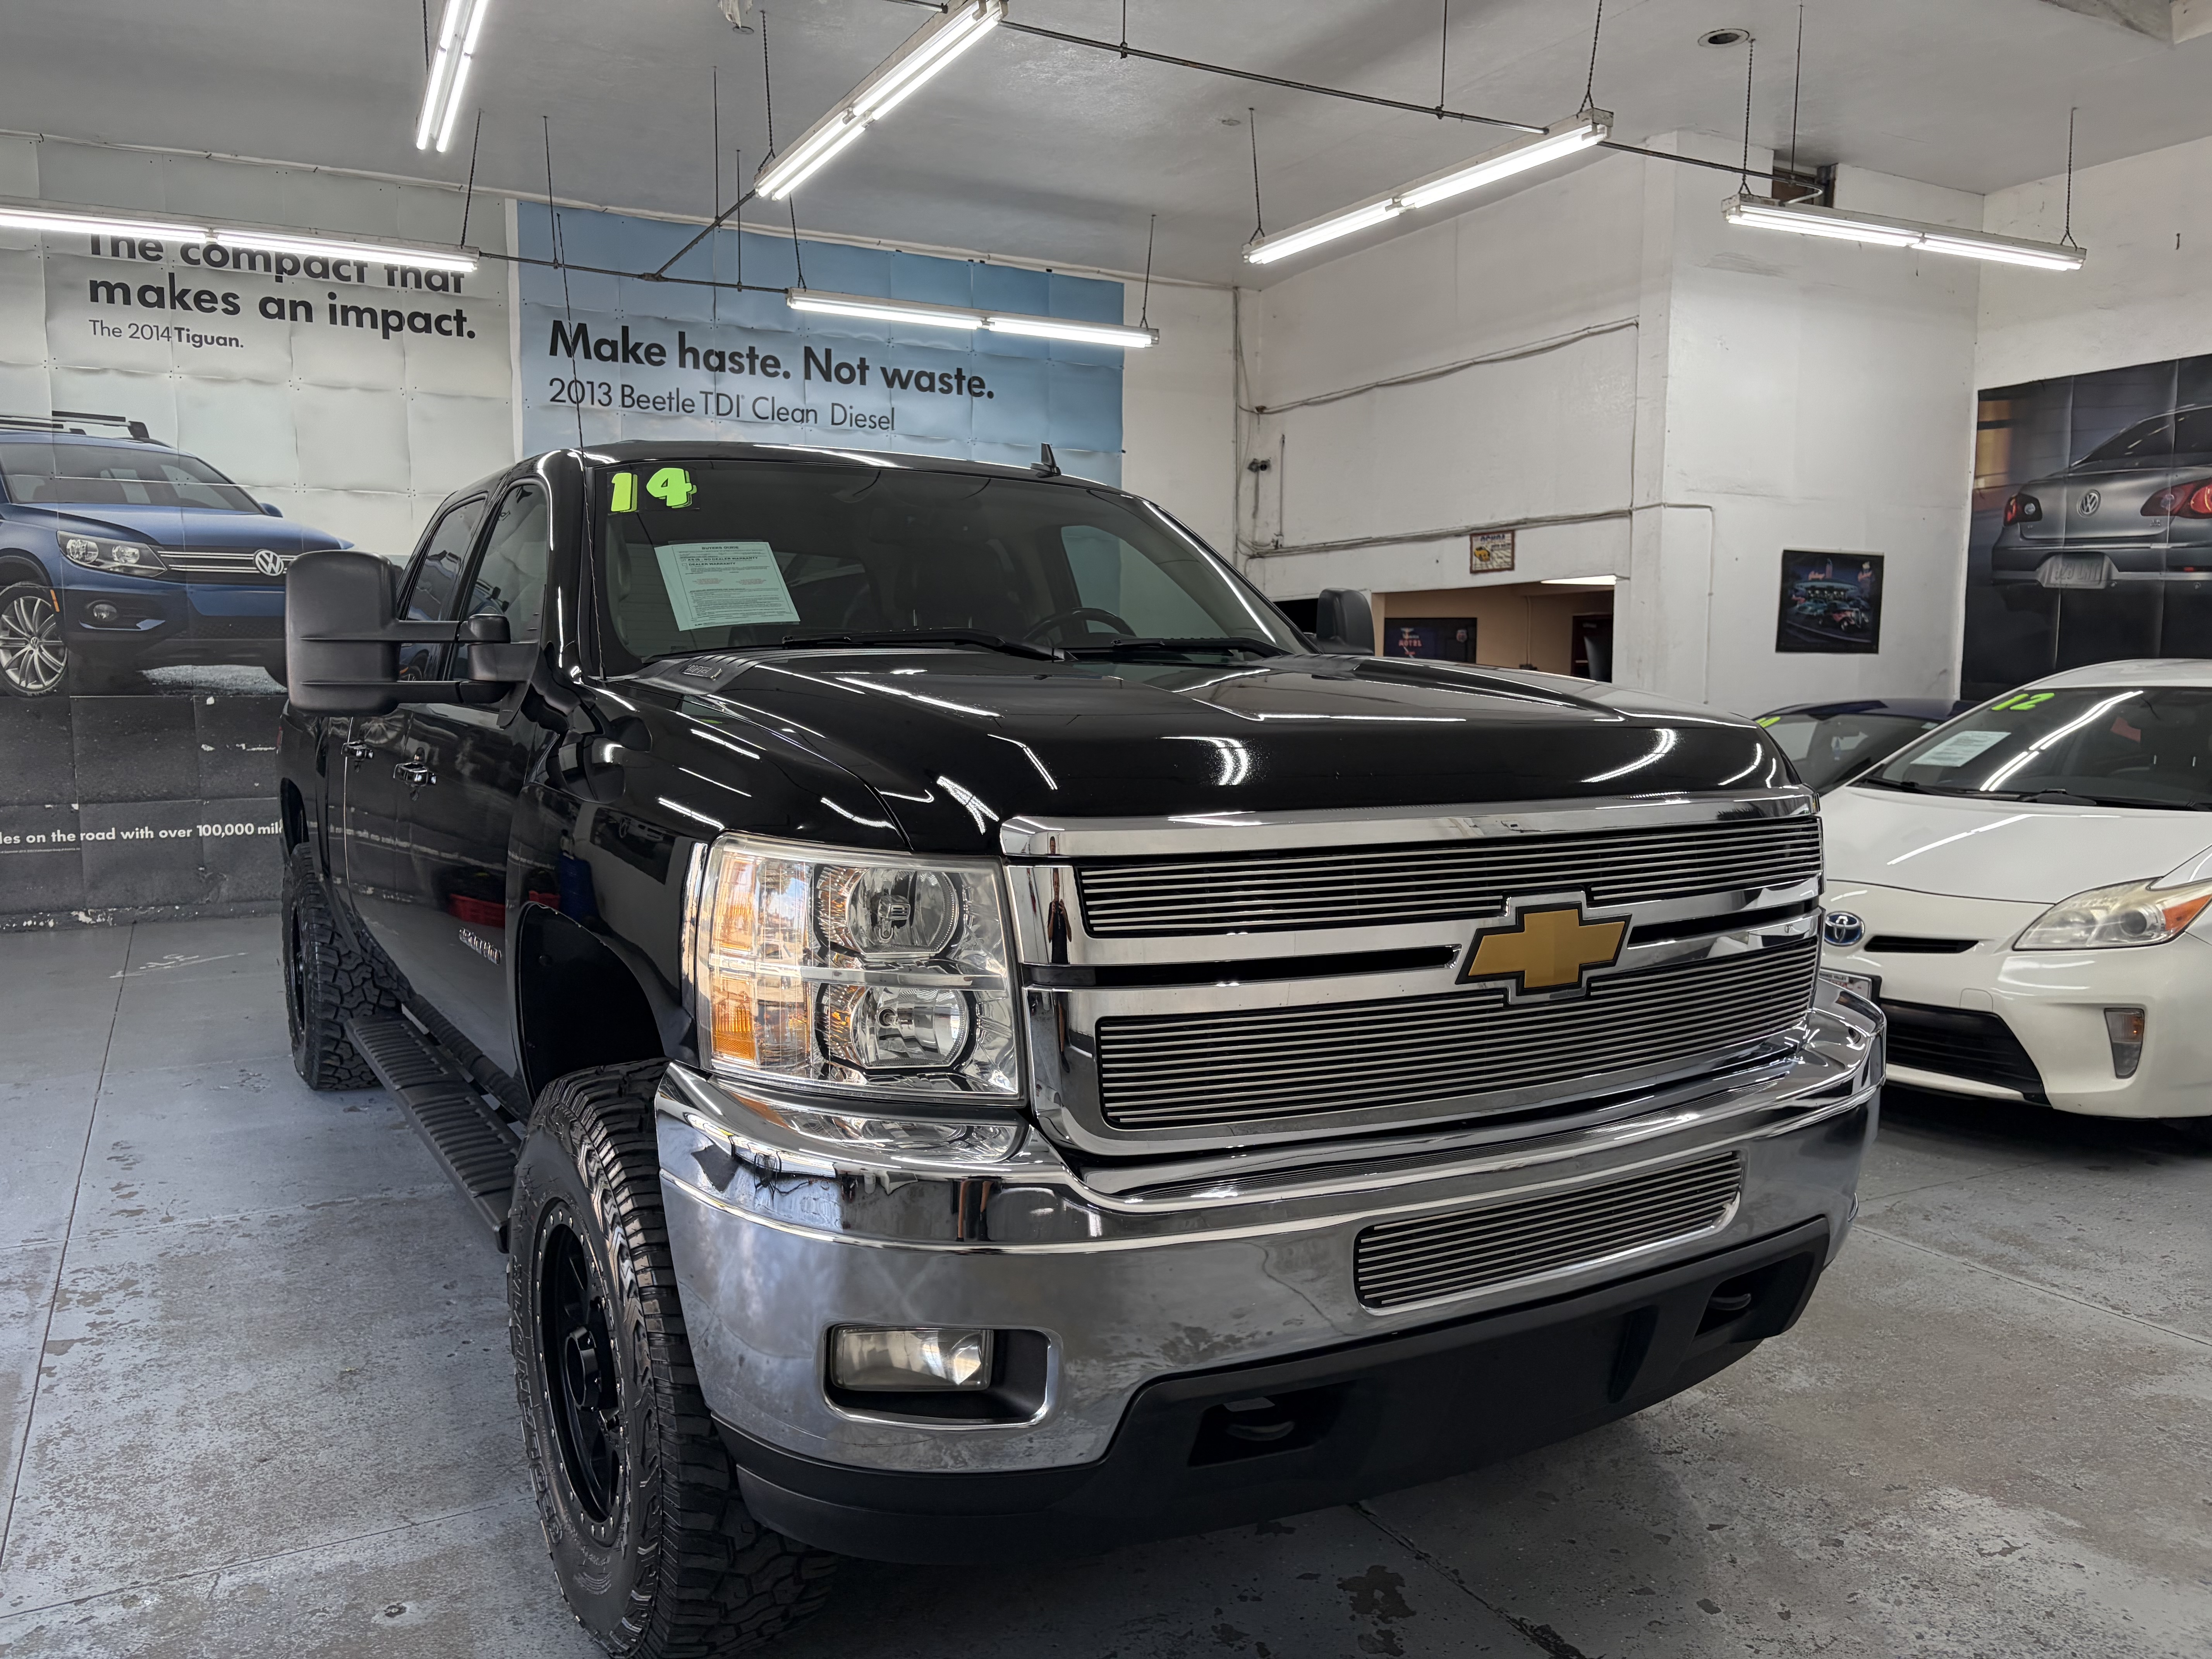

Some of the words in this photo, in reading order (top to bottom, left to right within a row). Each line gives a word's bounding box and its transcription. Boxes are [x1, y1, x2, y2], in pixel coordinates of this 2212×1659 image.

[91, 234, 163, 262] The
[180, 243, 368, 283] compact
[385, 266, 464, 294] that
[89, 273, 240, 315] makes
[259, 297, 313, 322] an
[328, 292, 476, 340] impact.
[89, 319, 122, 338] The
[128, 322, 171, 342] 2014
[174, 326, 244, 348] Tiguan.
[549, 320, 666, 366] Make
[678, 331, 791, 379] haste.
[804, 346, 870, 386] Not
[879, 366, 994, 400] waste.
[549, 378, 612, 407] 2013
[620, 383, 695, 414] Beetle
[752, 396, 818, 424] Clean
[831, 402, 895, 431] Diesel
[611, 467, 697, 513] 14
[1991, 692, 2055, 711] 12
[26, 835, 46, 843] on
[51, 830, 76, 842] the
[80, 827, 115, 841] road
[120, 826, 154, 839] with
[159, 829, 192, 838] over
[196, 823, 254, 838] 100,000
